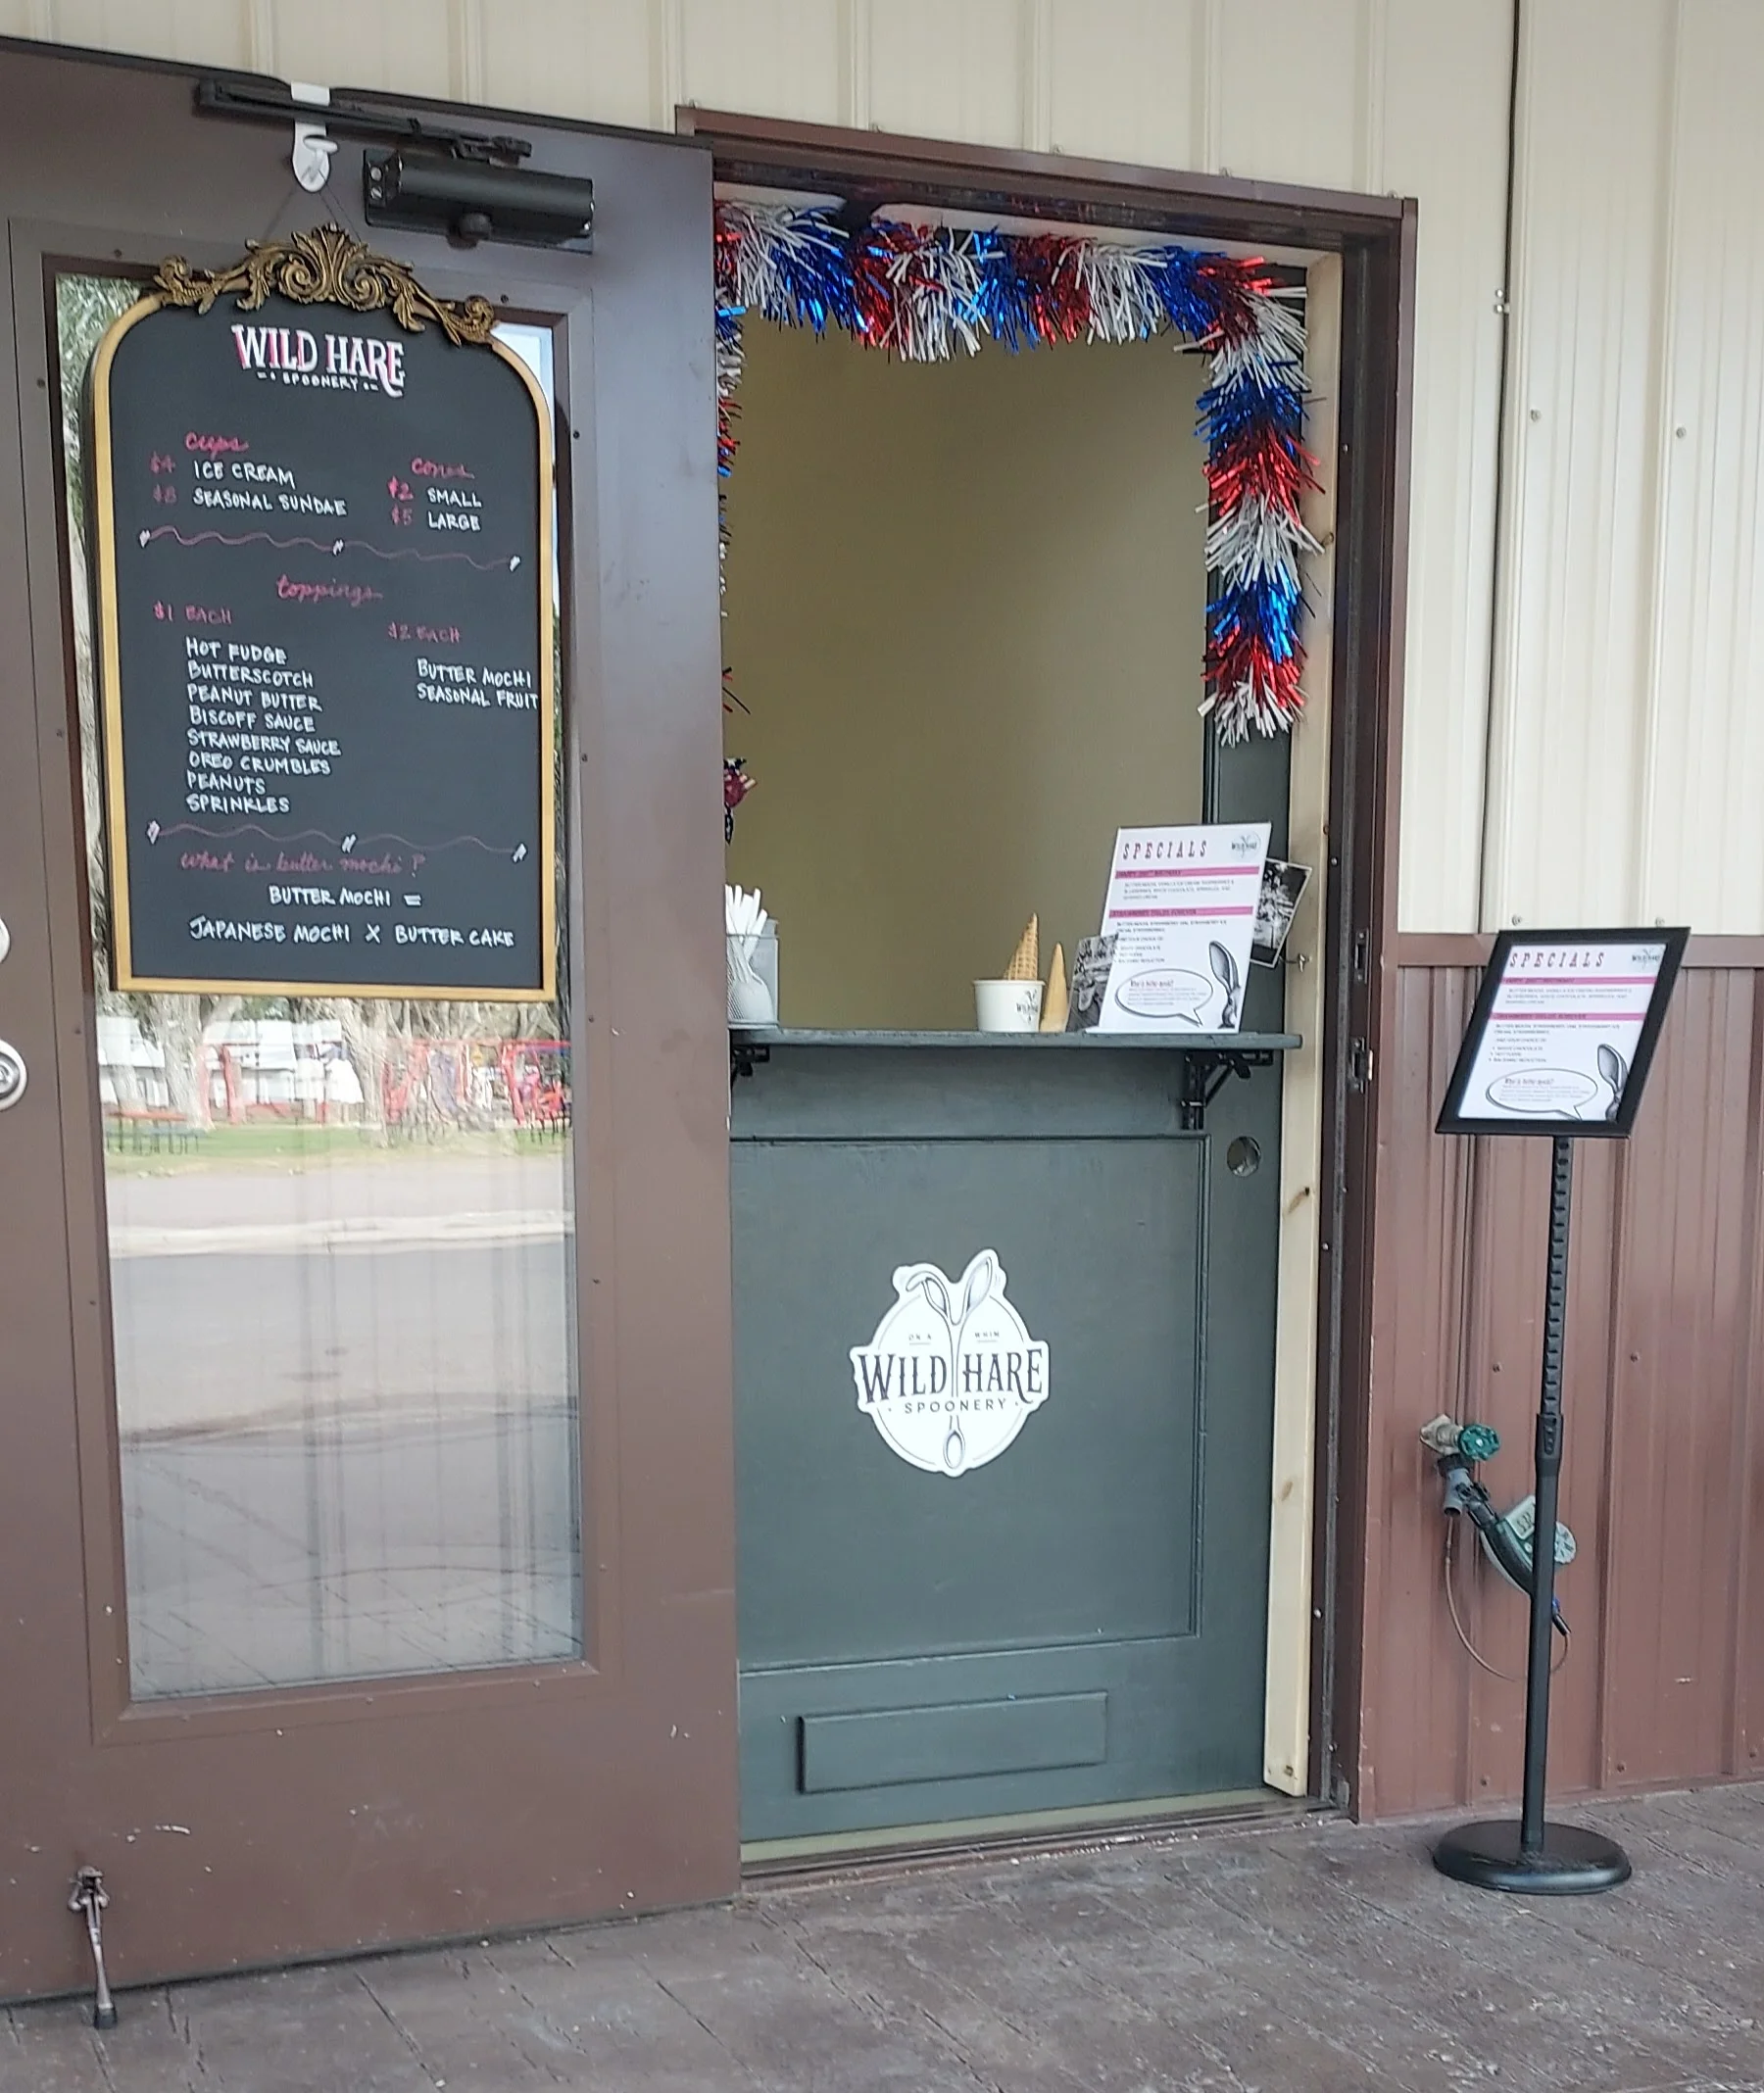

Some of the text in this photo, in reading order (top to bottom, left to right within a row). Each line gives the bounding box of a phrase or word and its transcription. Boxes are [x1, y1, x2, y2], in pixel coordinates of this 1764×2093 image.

[230, 323, 406, 397] WILD HARE
[282, 371, 359, 392] SPOONERY
[194, 460, 225, 480] ICE
[231, 462, 296, 490] CREAM
[193, 487, 273, 511] SEASONAL
[278, 493, 348, 517] SUNDAE
[388, 475, 483, 508] $2 SMALL
[427, 511, 481, 532] LARGE
[153, 600, 232, 625] $1 EACH
[388, 621, 461, 643] $2 EACH
[185, 636, 288, 665] HOT FUDGE
[187, 659, 314, 689] BUTTERSCOTCH
[416, 657, 533, 689] BUTTER MOCHI
[187, 683, 323, 712] PEANUT BUTTER
[416, 682, 539, 710] SEASONAL FRUIT
[188, 705, 316, 733] BISCOFF SAUCE
[186, 727, 342, 756] STRAWBERRY SAUCE
[188, 750, 331, 776] OREO CRUMBLES
[186, 769, 267, 796] PEANUTS
[185, 793, 291, 814] SPRINKLES
[1122, 840, 1208, 859] SPECIALS
[269, 885, 336, 906] BUTTER
[339, 887, 392, 907] MOCHI
[189, 914, 287, 943] JAPANESE
[293, 924, 351, 944] MOCHI
[394, 923, 465, 947] BUTTER
[468, 930, 515, 948] CAKE
[1509, 951, 1605, 968] SPECIALS
[857, 1348, 1044, 1404] WILD HARE
[904, 1397, 1007, 1414] SPOONERY
